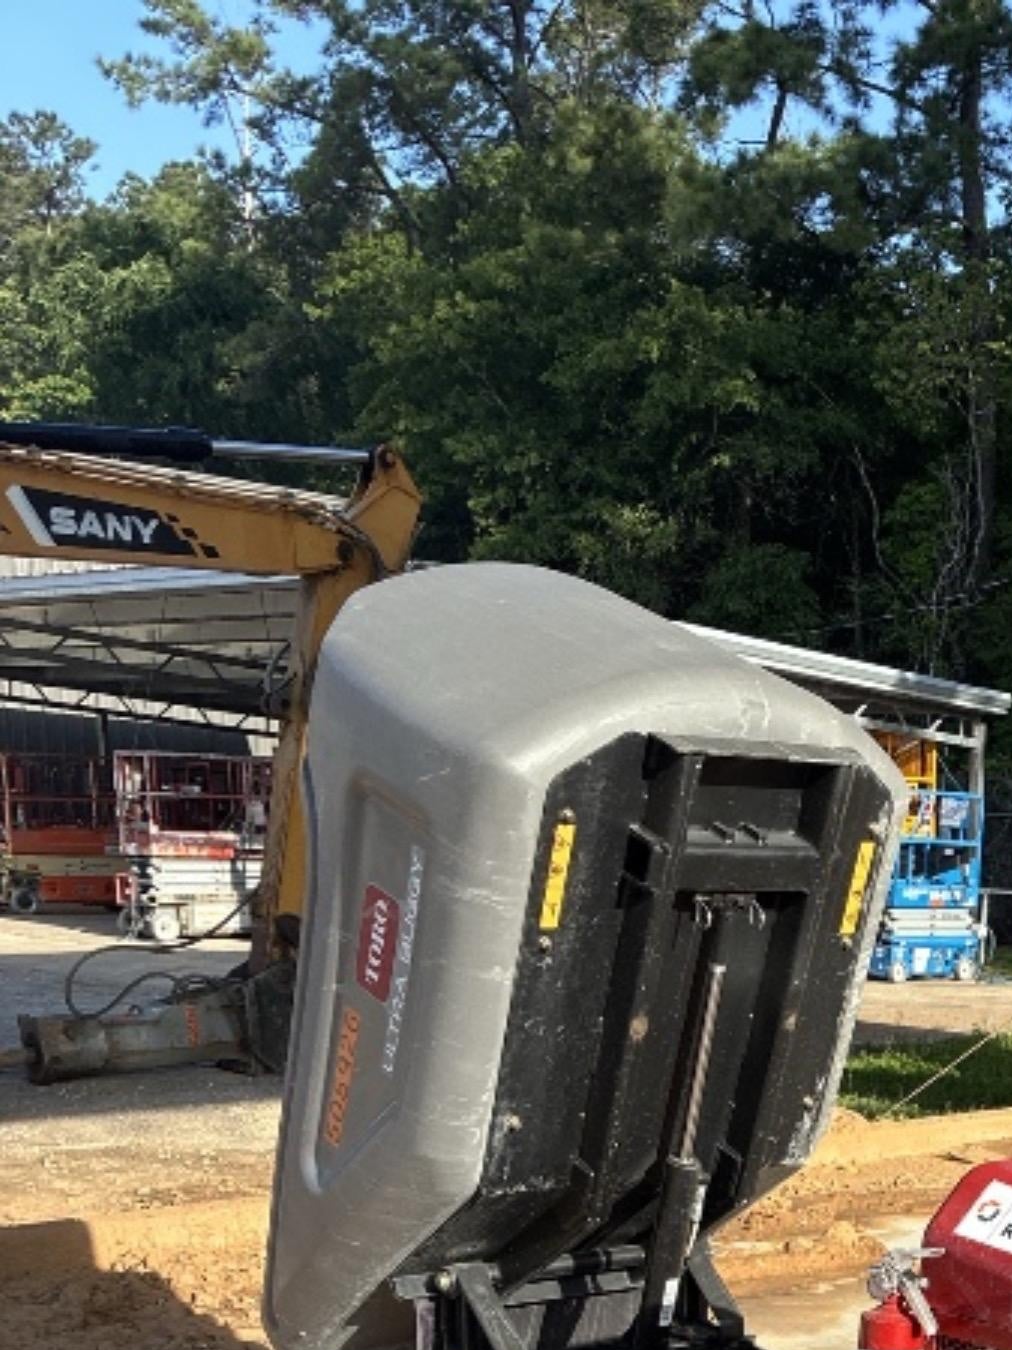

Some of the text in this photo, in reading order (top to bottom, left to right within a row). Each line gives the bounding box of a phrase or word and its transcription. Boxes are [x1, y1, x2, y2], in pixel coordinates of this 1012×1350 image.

[49, 505, 160, 544] SANY
[365, 899, 390, 984] TORO
[382, 976, 407, 1072] ULTRA
